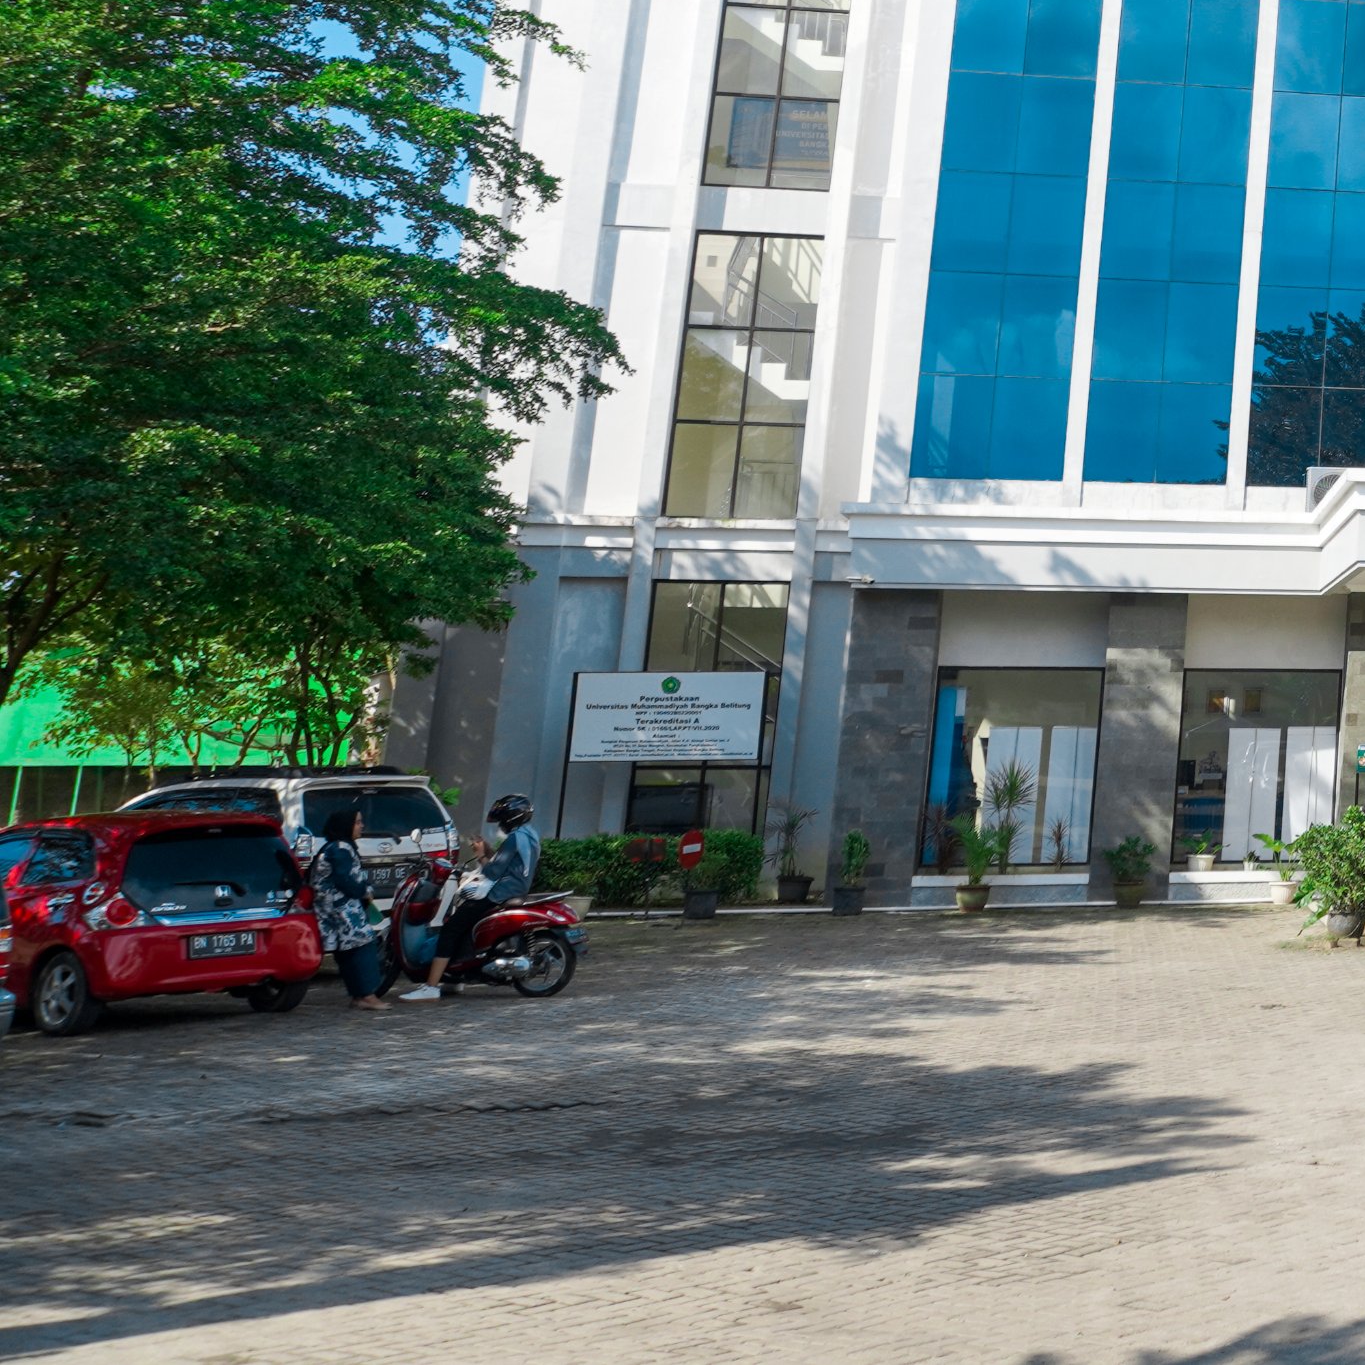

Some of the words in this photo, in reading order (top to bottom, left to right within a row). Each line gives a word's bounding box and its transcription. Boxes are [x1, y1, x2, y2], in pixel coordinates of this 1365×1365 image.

[639, 695, 700, 703] Perpustakaan
[720, 702, 752, 710] Belitung
[194, 936, 207, 949] BN
[212, 934, 236, 947] 1765
[240, 932, 254, 945] PA
